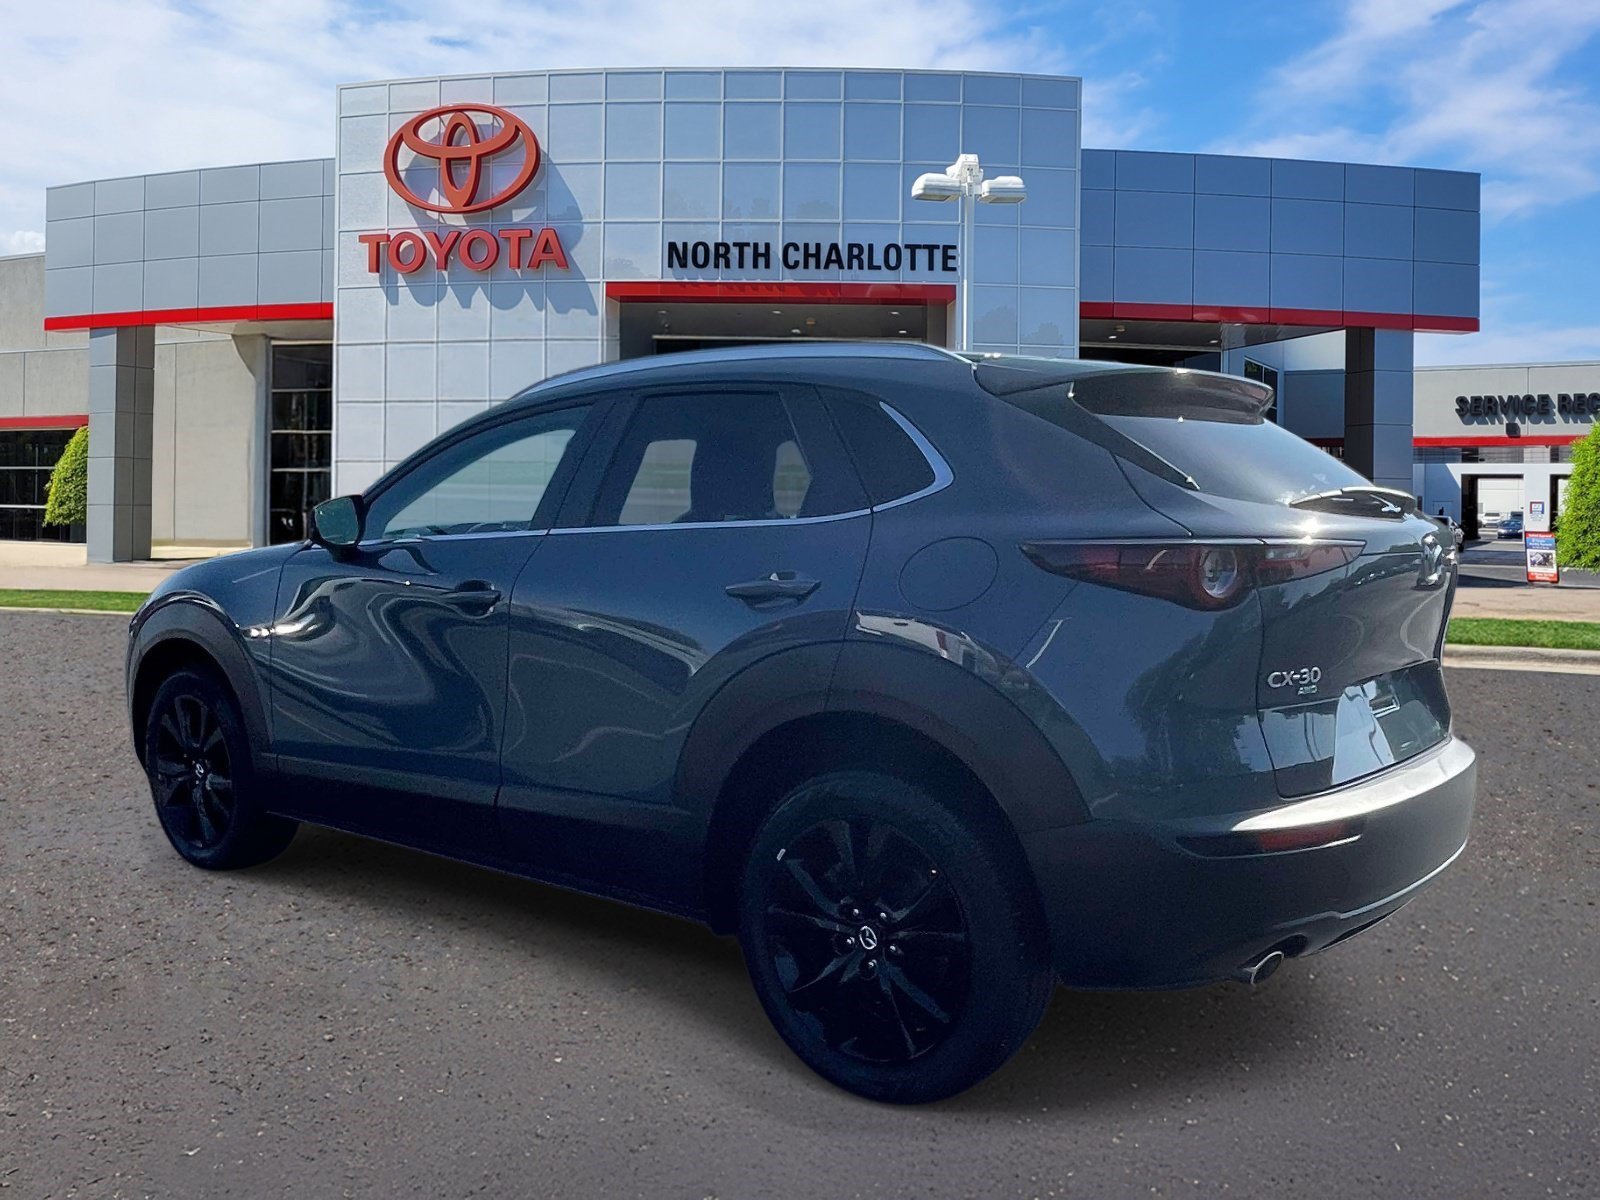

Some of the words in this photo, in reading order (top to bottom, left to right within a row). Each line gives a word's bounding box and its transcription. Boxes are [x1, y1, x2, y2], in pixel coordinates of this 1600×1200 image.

[358, 228, 569, 274] TOYOTA
[667, 241, 771, 269] NORTH
[782, 242, 957, 272] CHARLOTTE
[1455, 394, 1551, 416] SERVICE
[1557, 392, 1600, 415] REC
[1267, 666, 1322, 688] CX-30
